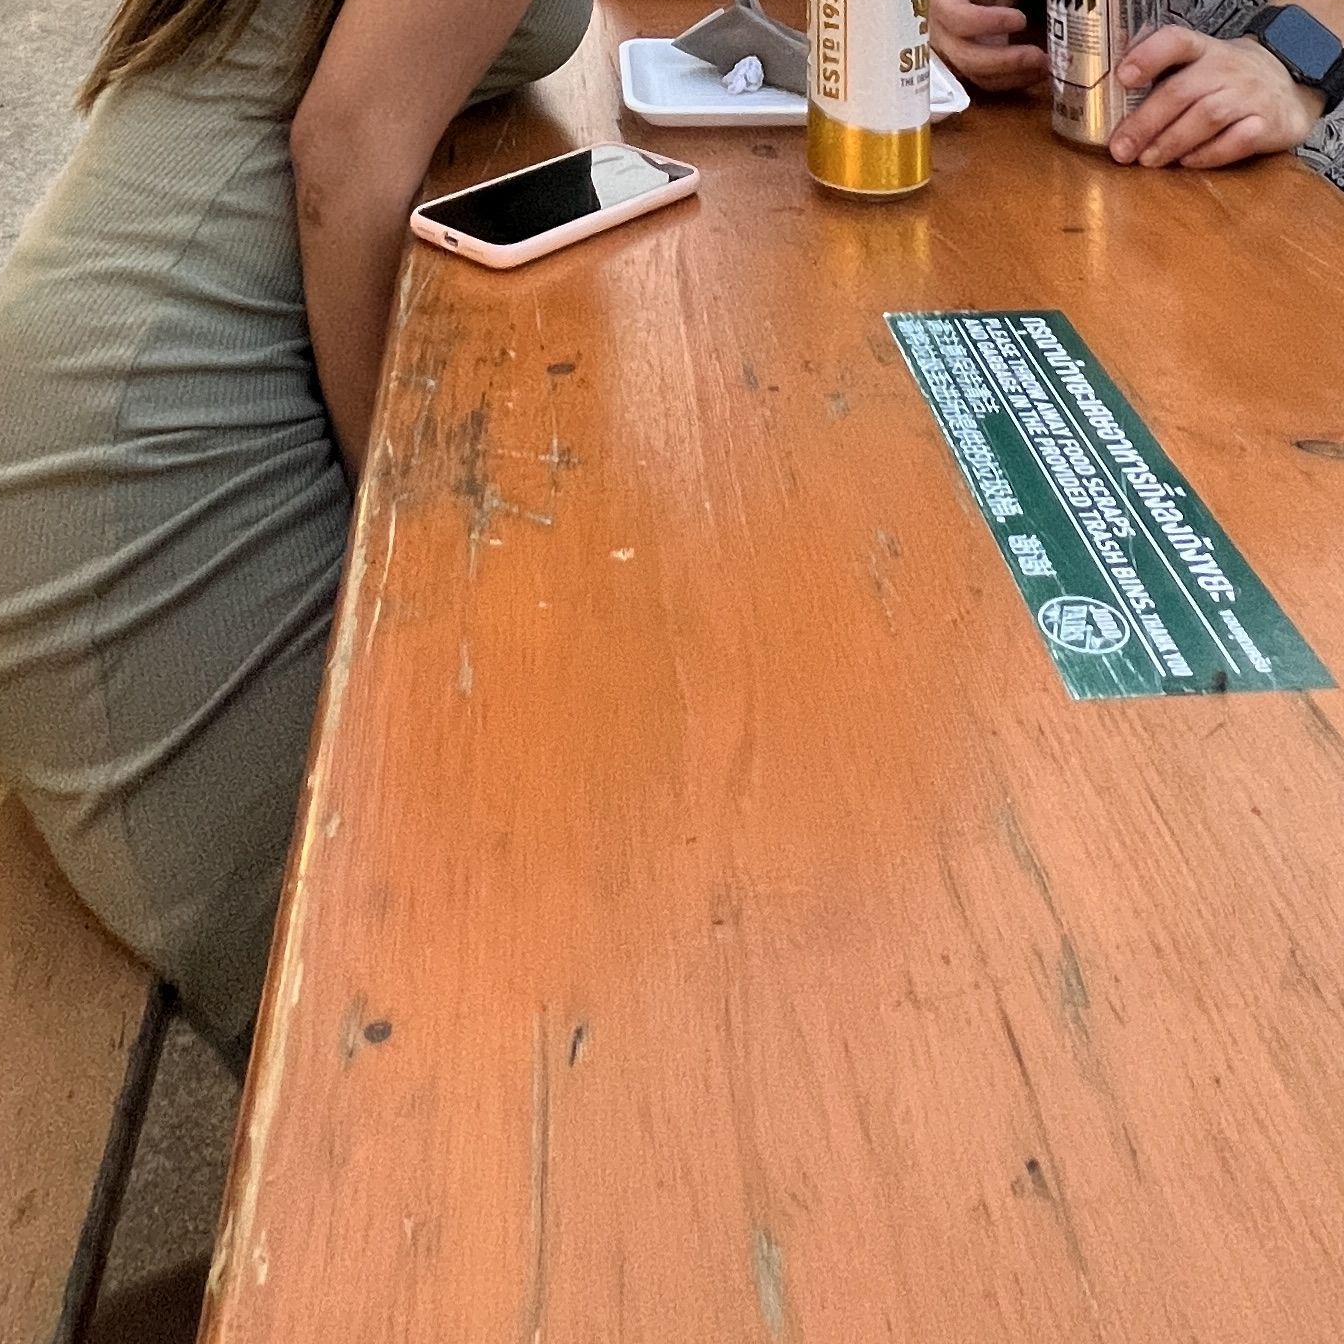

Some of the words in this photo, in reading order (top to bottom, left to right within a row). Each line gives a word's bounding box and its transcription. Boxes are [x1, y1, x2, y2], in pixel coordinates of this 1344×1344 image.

[962, 319, 989, 340] AND
[977, 342, 1023, 393] GARBAGE
[1008, 395, 1032, 409] IN
[982, 319, 1021, 357] PLEASE
[1008, 358, 1049, 400] THROW
[1034, 401, 1073, 436] AWAY
[1057, 439, 1096, 475] FOOD
[1082, 478, 1136, 538] SCRAPS
[1018, 410, 1049, 435] THE
[1034, 438, 1092, 507] PROVIDED
[1079, 509, 1128, 564] TRASH
[1139, 613, 1179, 653] THANK
[1163, 652, 1193, 676] YOU
